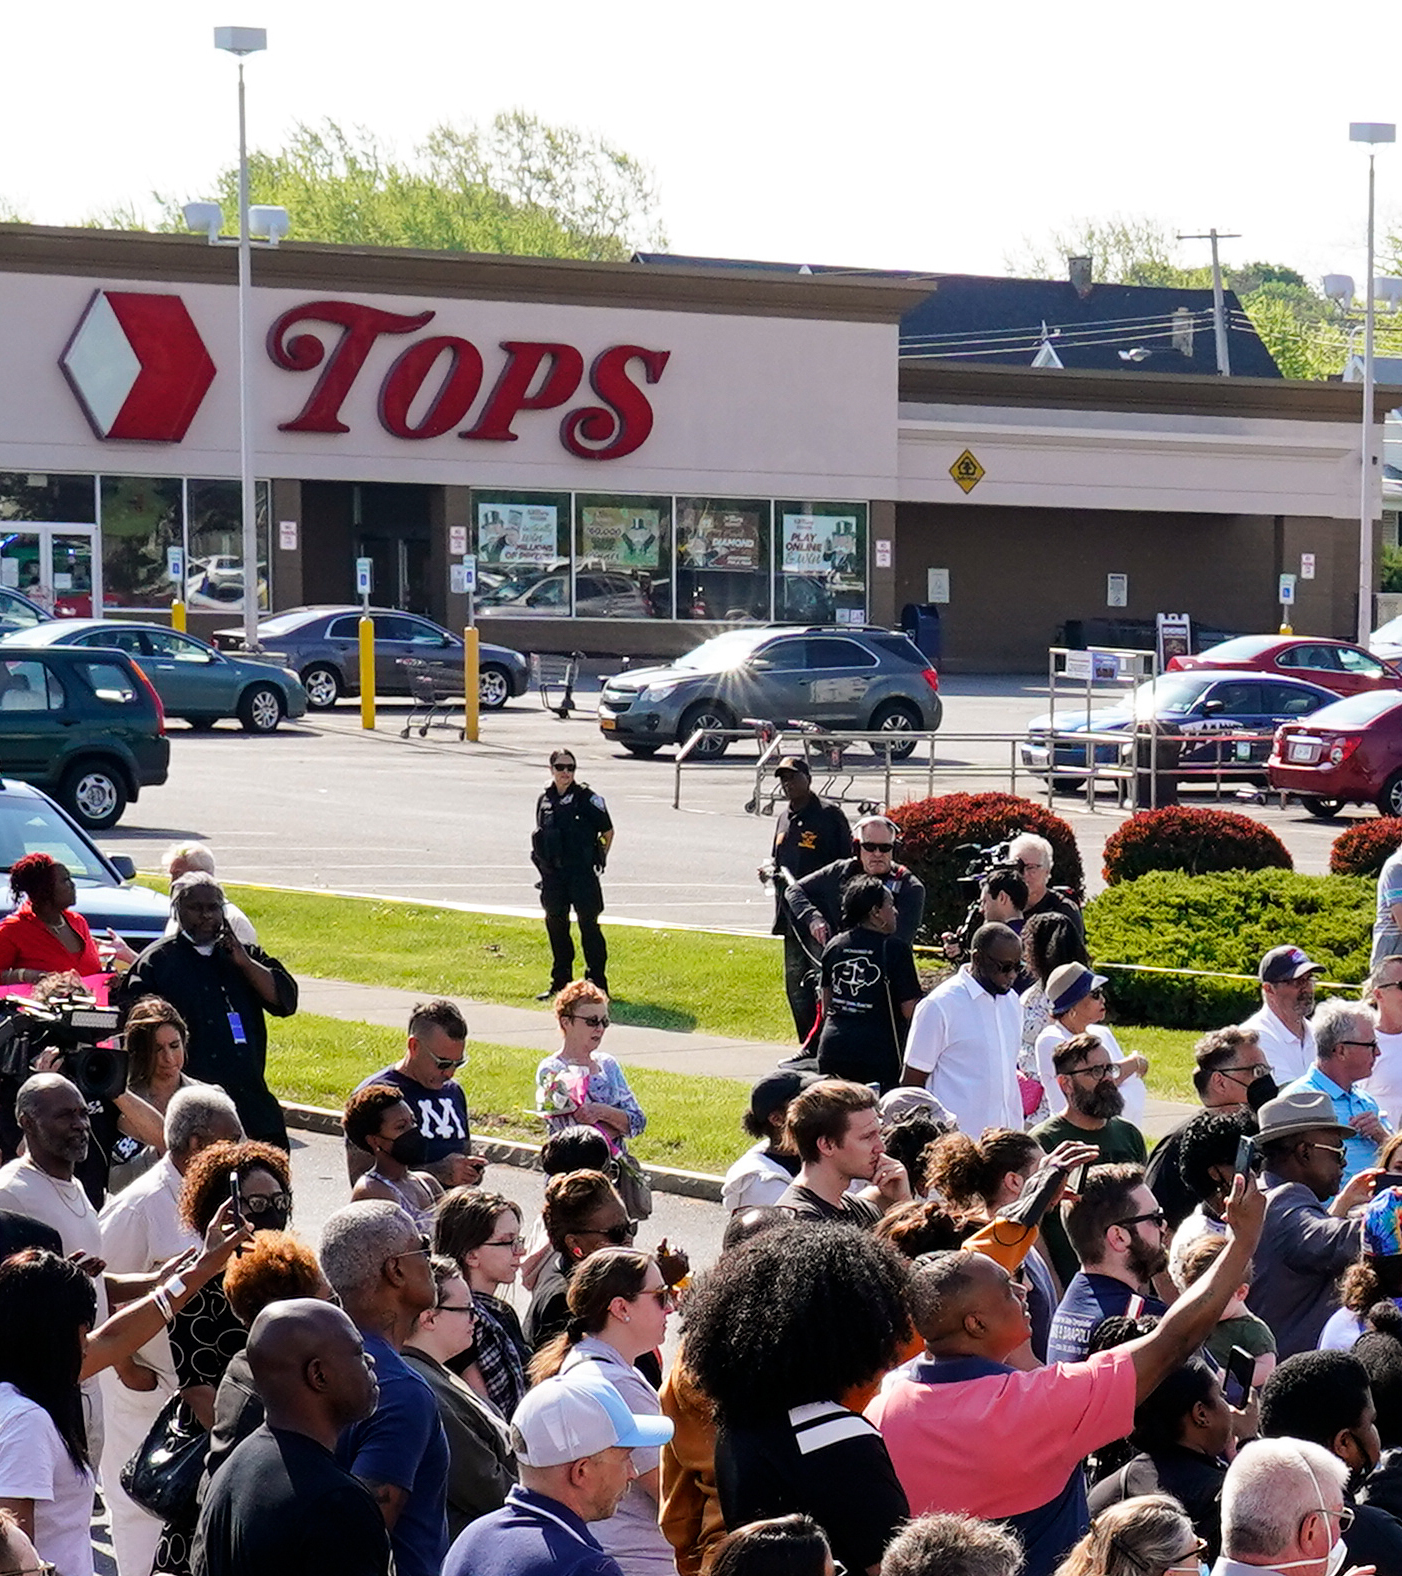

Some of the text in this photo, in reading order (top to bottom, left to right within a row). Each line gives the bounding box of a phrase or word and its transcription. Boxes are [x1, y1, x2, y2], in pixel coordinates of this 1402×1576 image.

[266, 300, 671, 461] TOPS
[791, 532, 817, 542] PLAY
[786, 542, 822, 552] ONLINE
